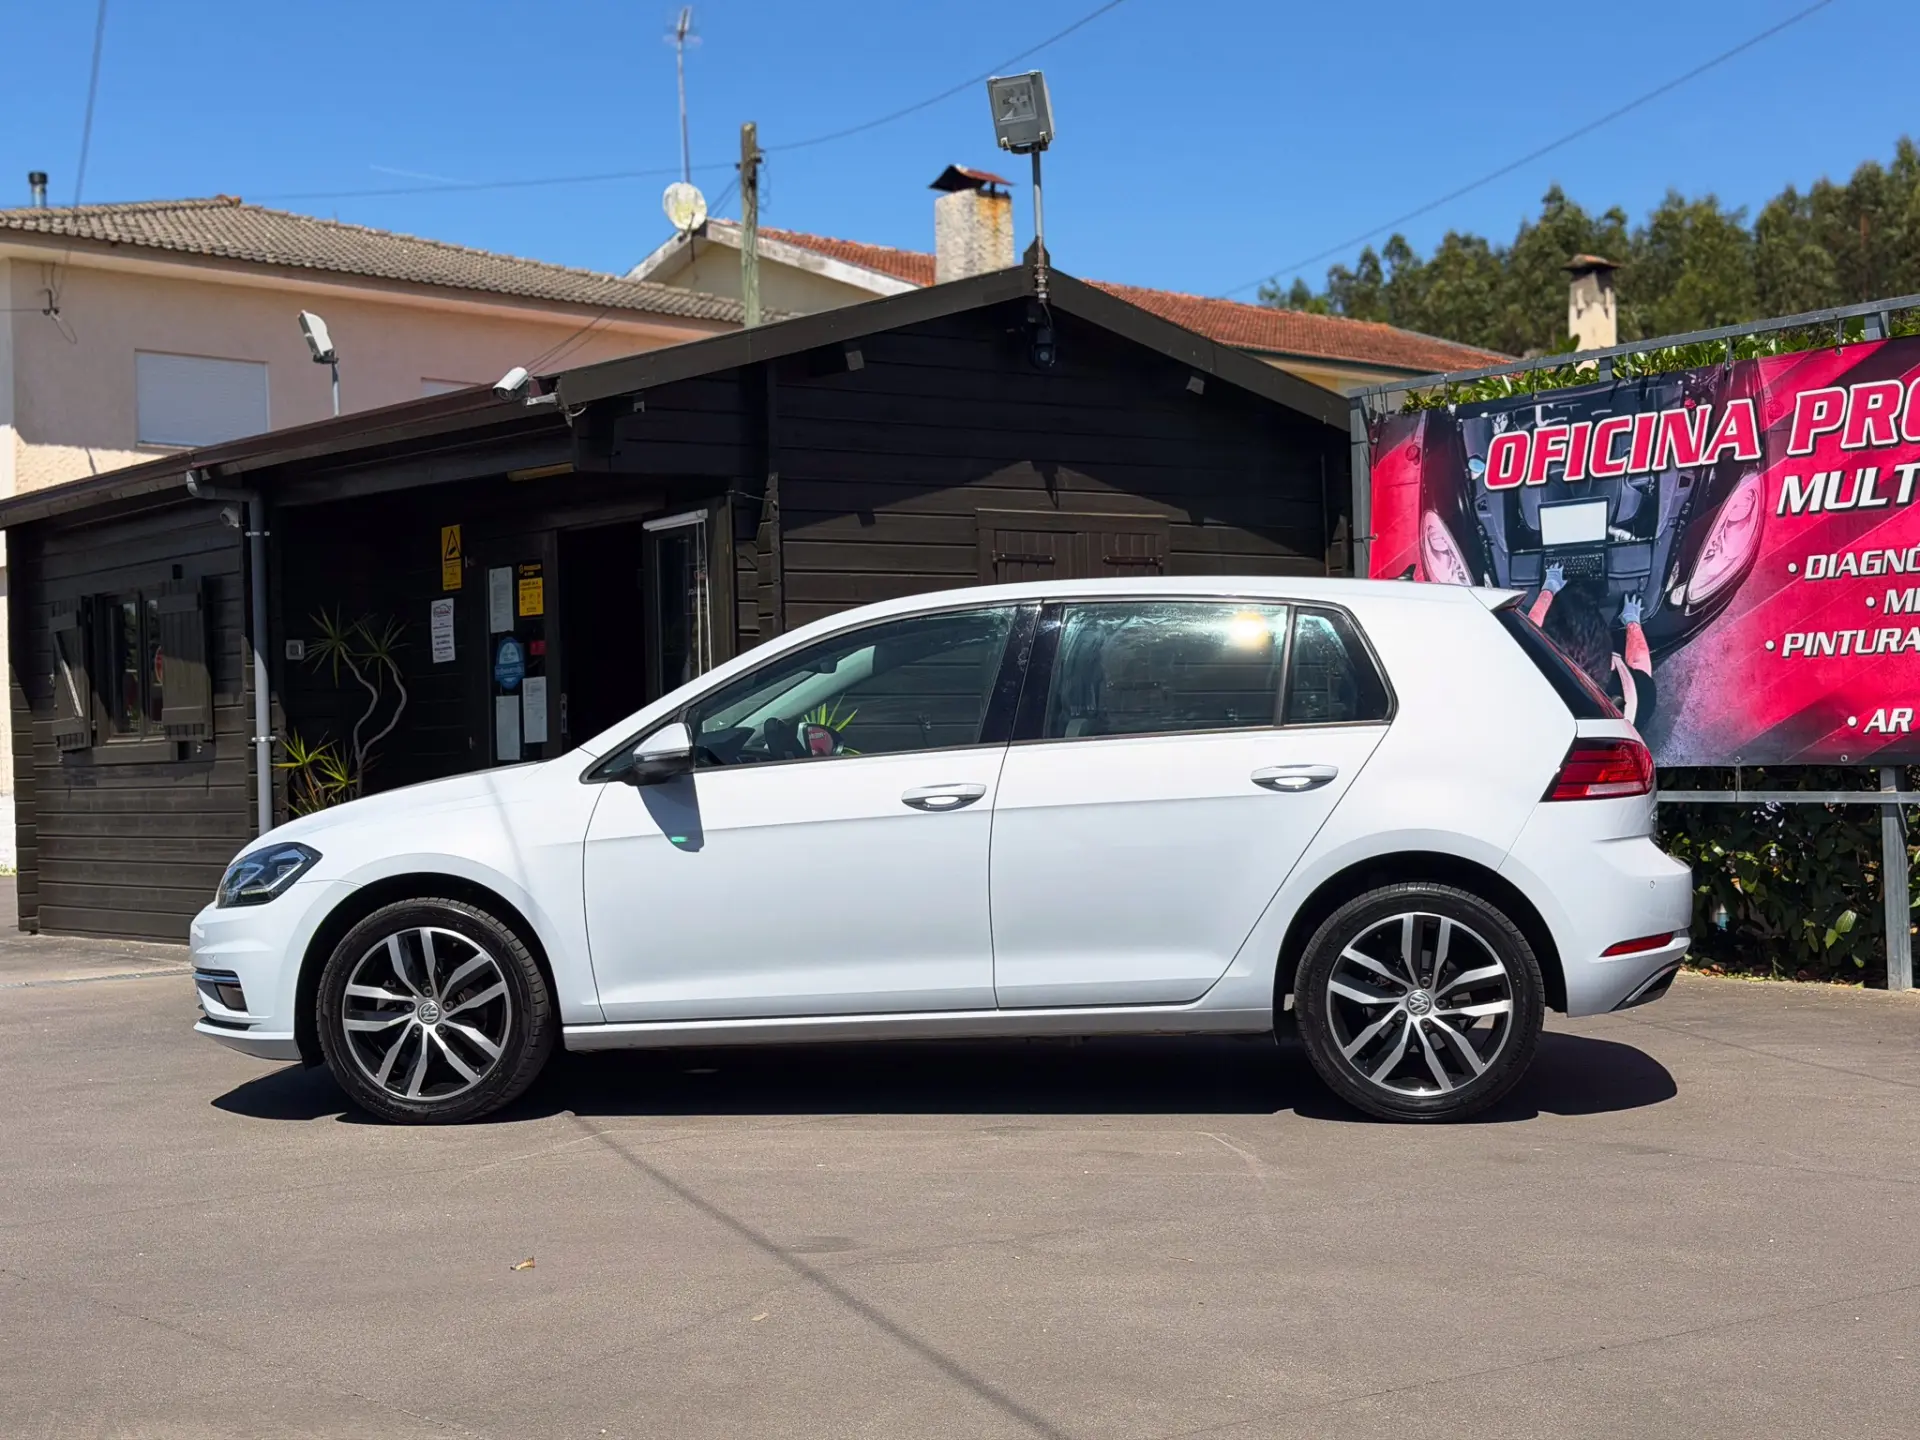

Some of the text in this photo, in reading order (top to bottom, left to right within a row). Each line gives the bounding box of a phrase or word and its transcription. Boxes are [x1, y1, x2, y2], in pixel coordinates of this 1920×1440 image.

[1484, 398, 1761, 489] OFICINA
[1781, 627, 1920, 657] PINTURA
[1863, 707, 1913, 734] AR
